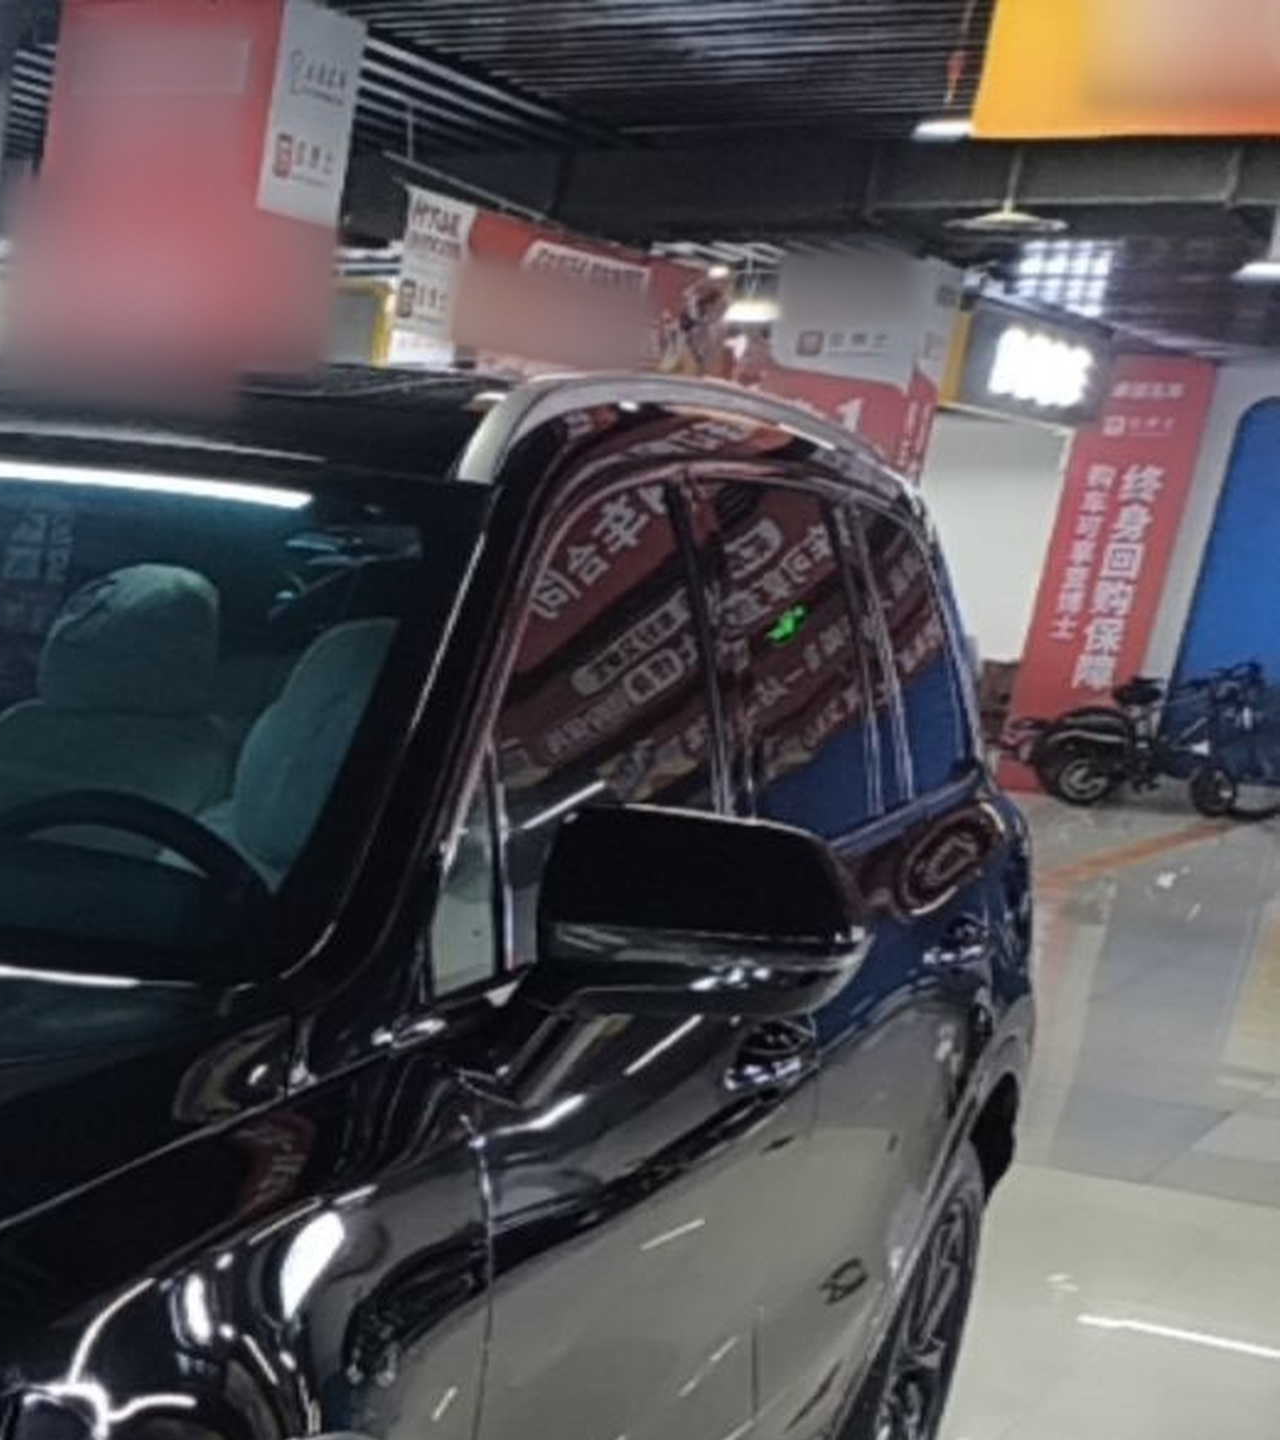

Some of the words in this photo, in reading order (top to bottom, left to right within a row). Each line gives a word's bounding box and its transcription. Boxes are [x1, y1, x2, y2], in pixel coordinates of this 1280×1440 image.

[1071, 464, 1166, 690] 终身回购保障
